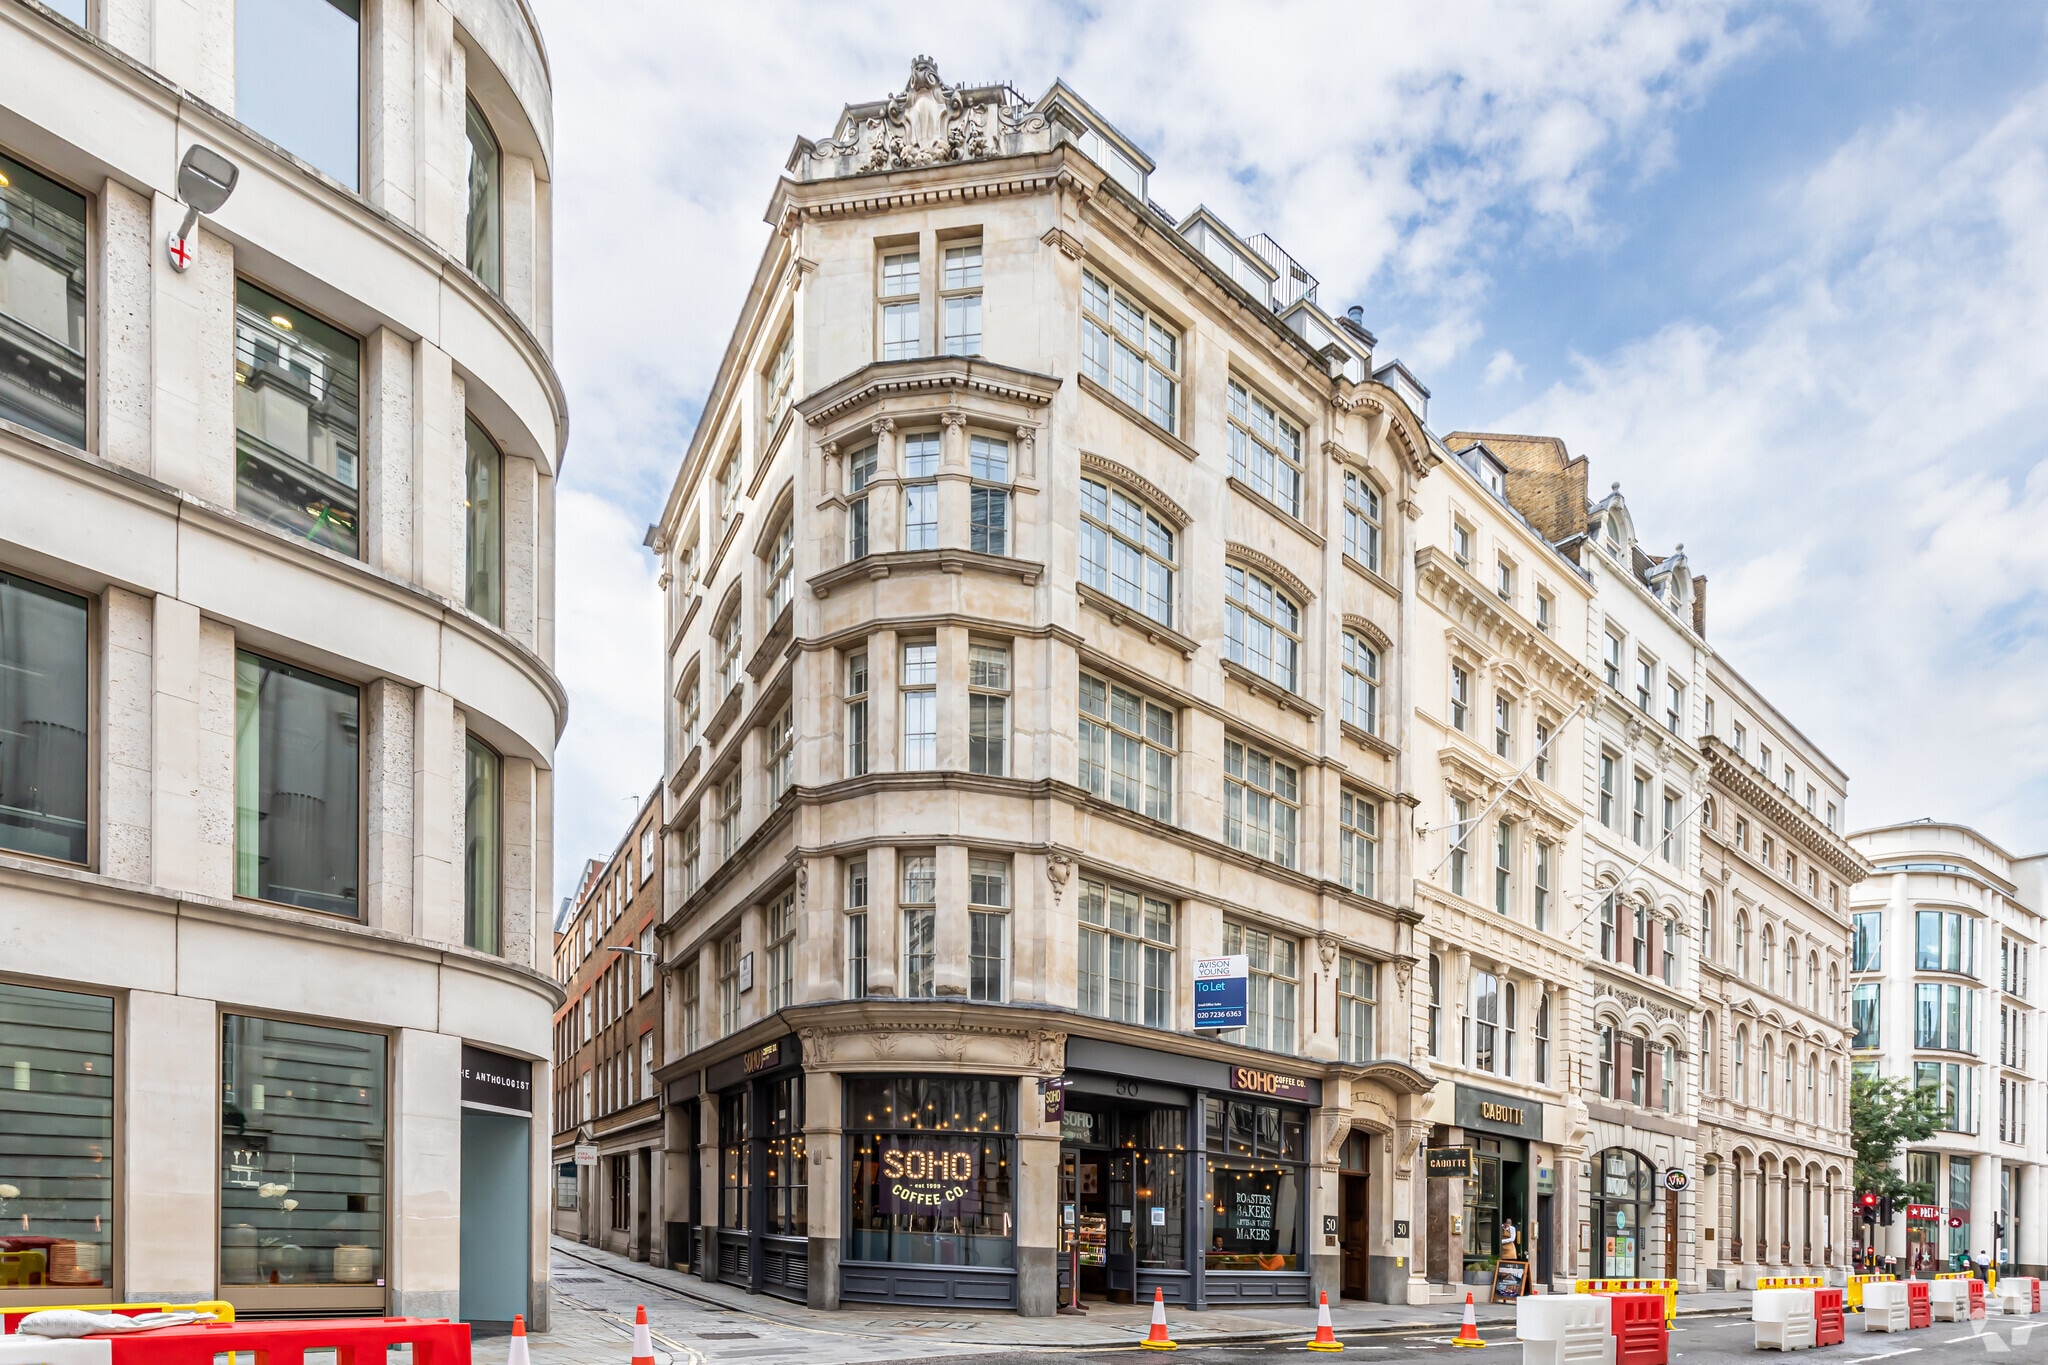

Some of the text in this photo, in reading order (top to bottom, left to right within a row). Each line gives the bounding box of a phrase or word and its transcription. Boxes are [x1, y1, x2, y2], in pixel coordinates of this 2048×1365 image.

[1198, 960, 1230, 969] AVISON
[1198, 967, 1230, 976] YOUNG
[1196, 981, 1226, 992] To Let
[461, 1068, 530, 1091] HE ANTHOLOGIST
[1237, 1068, 1277, 1094] SOHO
[1275, 1075, 1296, 1086] COFFEE
[1045, 1089, 1061, 1104] SOHO
[1116, 1080, 1139, 1098] 50
[1062, 1111, 1094, 1129] SOHO
[1481, 1101, 1524, 1126] CABOTTE
[883, 1149, 972, 1182] SOHO
[1430, 1159, 1467, 1169] CABOTTE
[892, 1184, 969, 1206] COFFEE CO.
[1325, 1218, 1336, 1232] 50
[1397, 1223, 1407, 1236] 50
[1236, 1227, 1271, 1241] MAKERS
